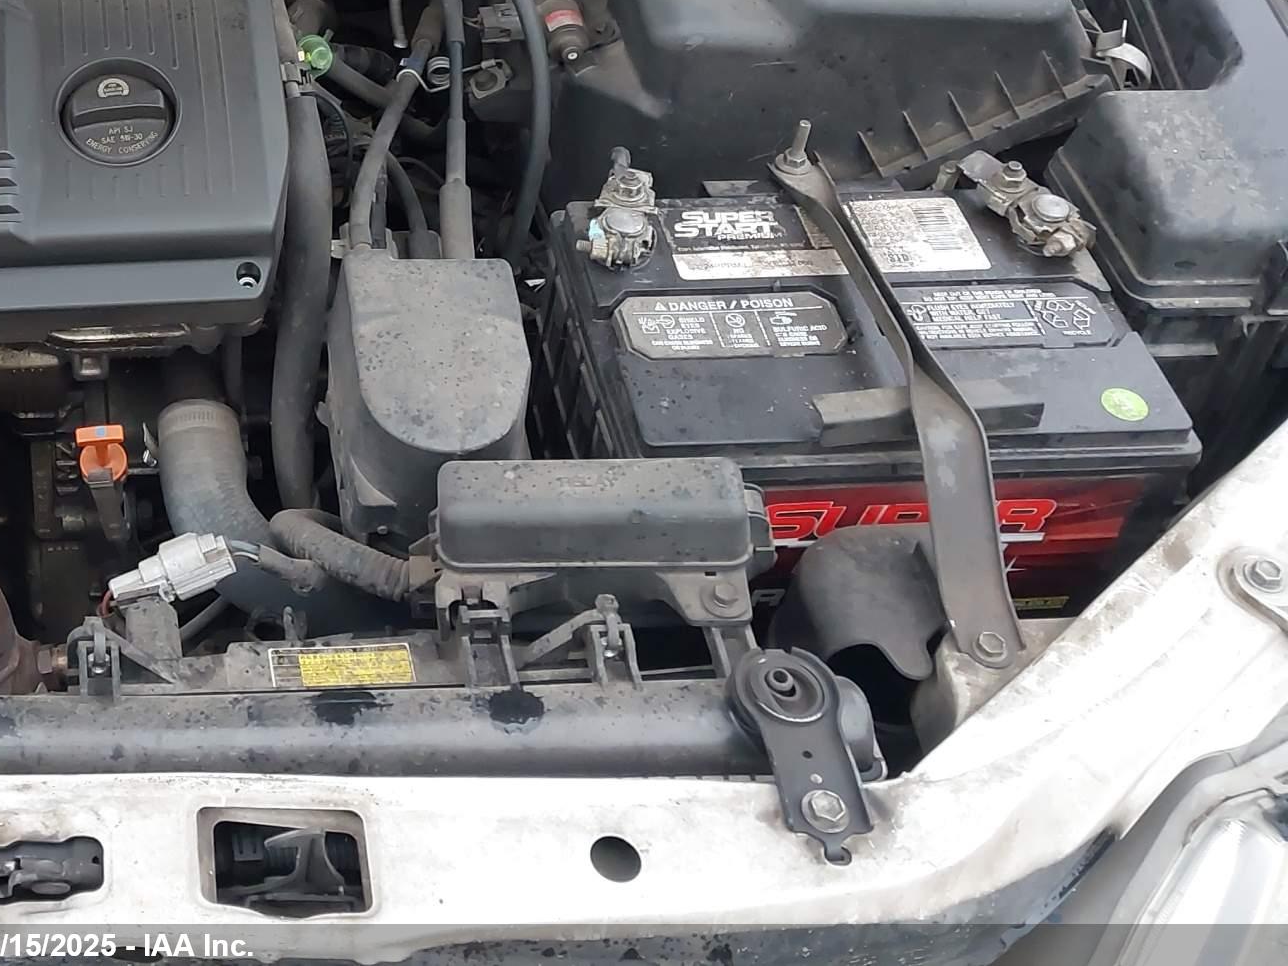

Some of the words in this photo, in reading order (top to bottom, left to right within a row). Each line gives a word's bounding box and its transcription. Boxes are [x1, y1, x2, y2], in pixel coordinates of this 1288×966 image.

[681, 210, 775, 224] SUPER
[674, 223, 779, 237] START
[668, 301, 726, 312] DANGER
[740, 298, 794, 309] POISON
[765, 497, 1057, 537] SUPR
